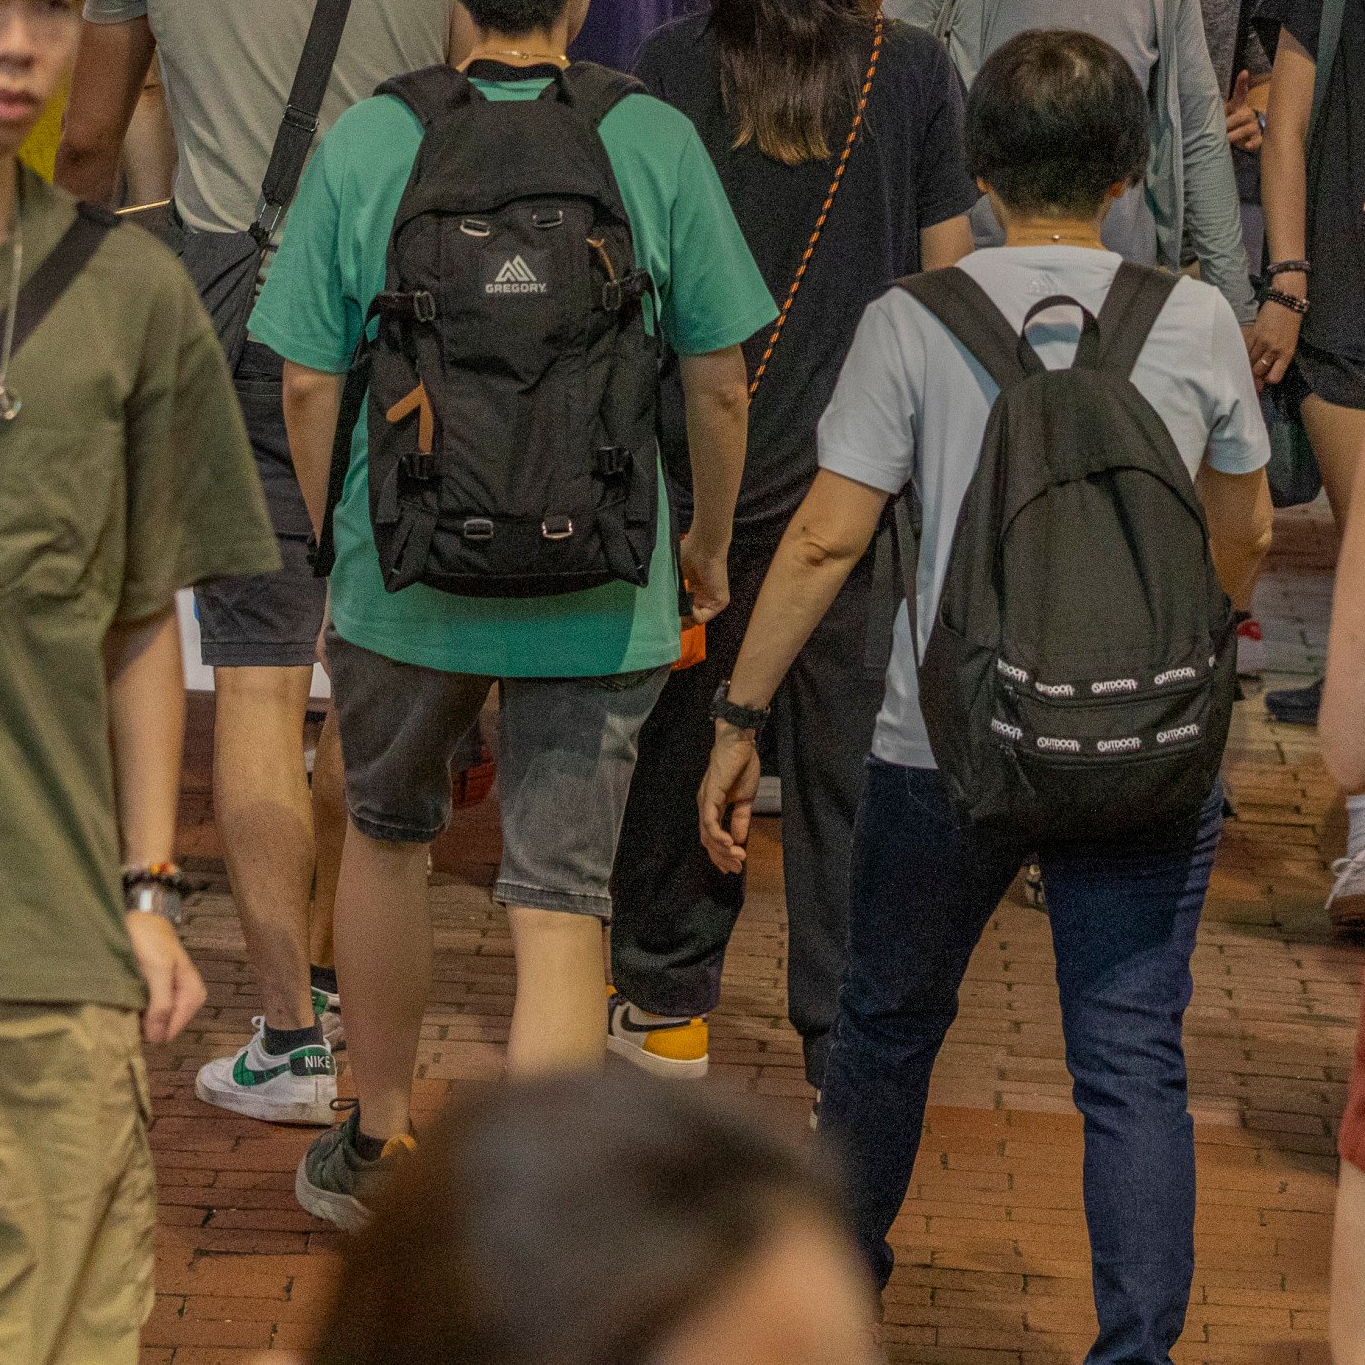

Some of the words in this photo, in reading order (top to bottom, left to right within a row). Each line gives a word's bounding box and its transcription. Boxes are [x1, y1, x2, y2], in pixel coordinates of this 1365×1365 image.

[485, 283, 546, 293] GREGORY
[1091, 678, 1138, 694] OUTDOOR
[1154, 666, 1196, 685] OUTDOOR
[1037, 737, 1081, 752] OUTDOOR
[1097, 737, 1142, 752] OUTDOOR
[1156, 723, 1199, 743] OUTDOOR
[305, 1056, 330, 1068] NIKE
